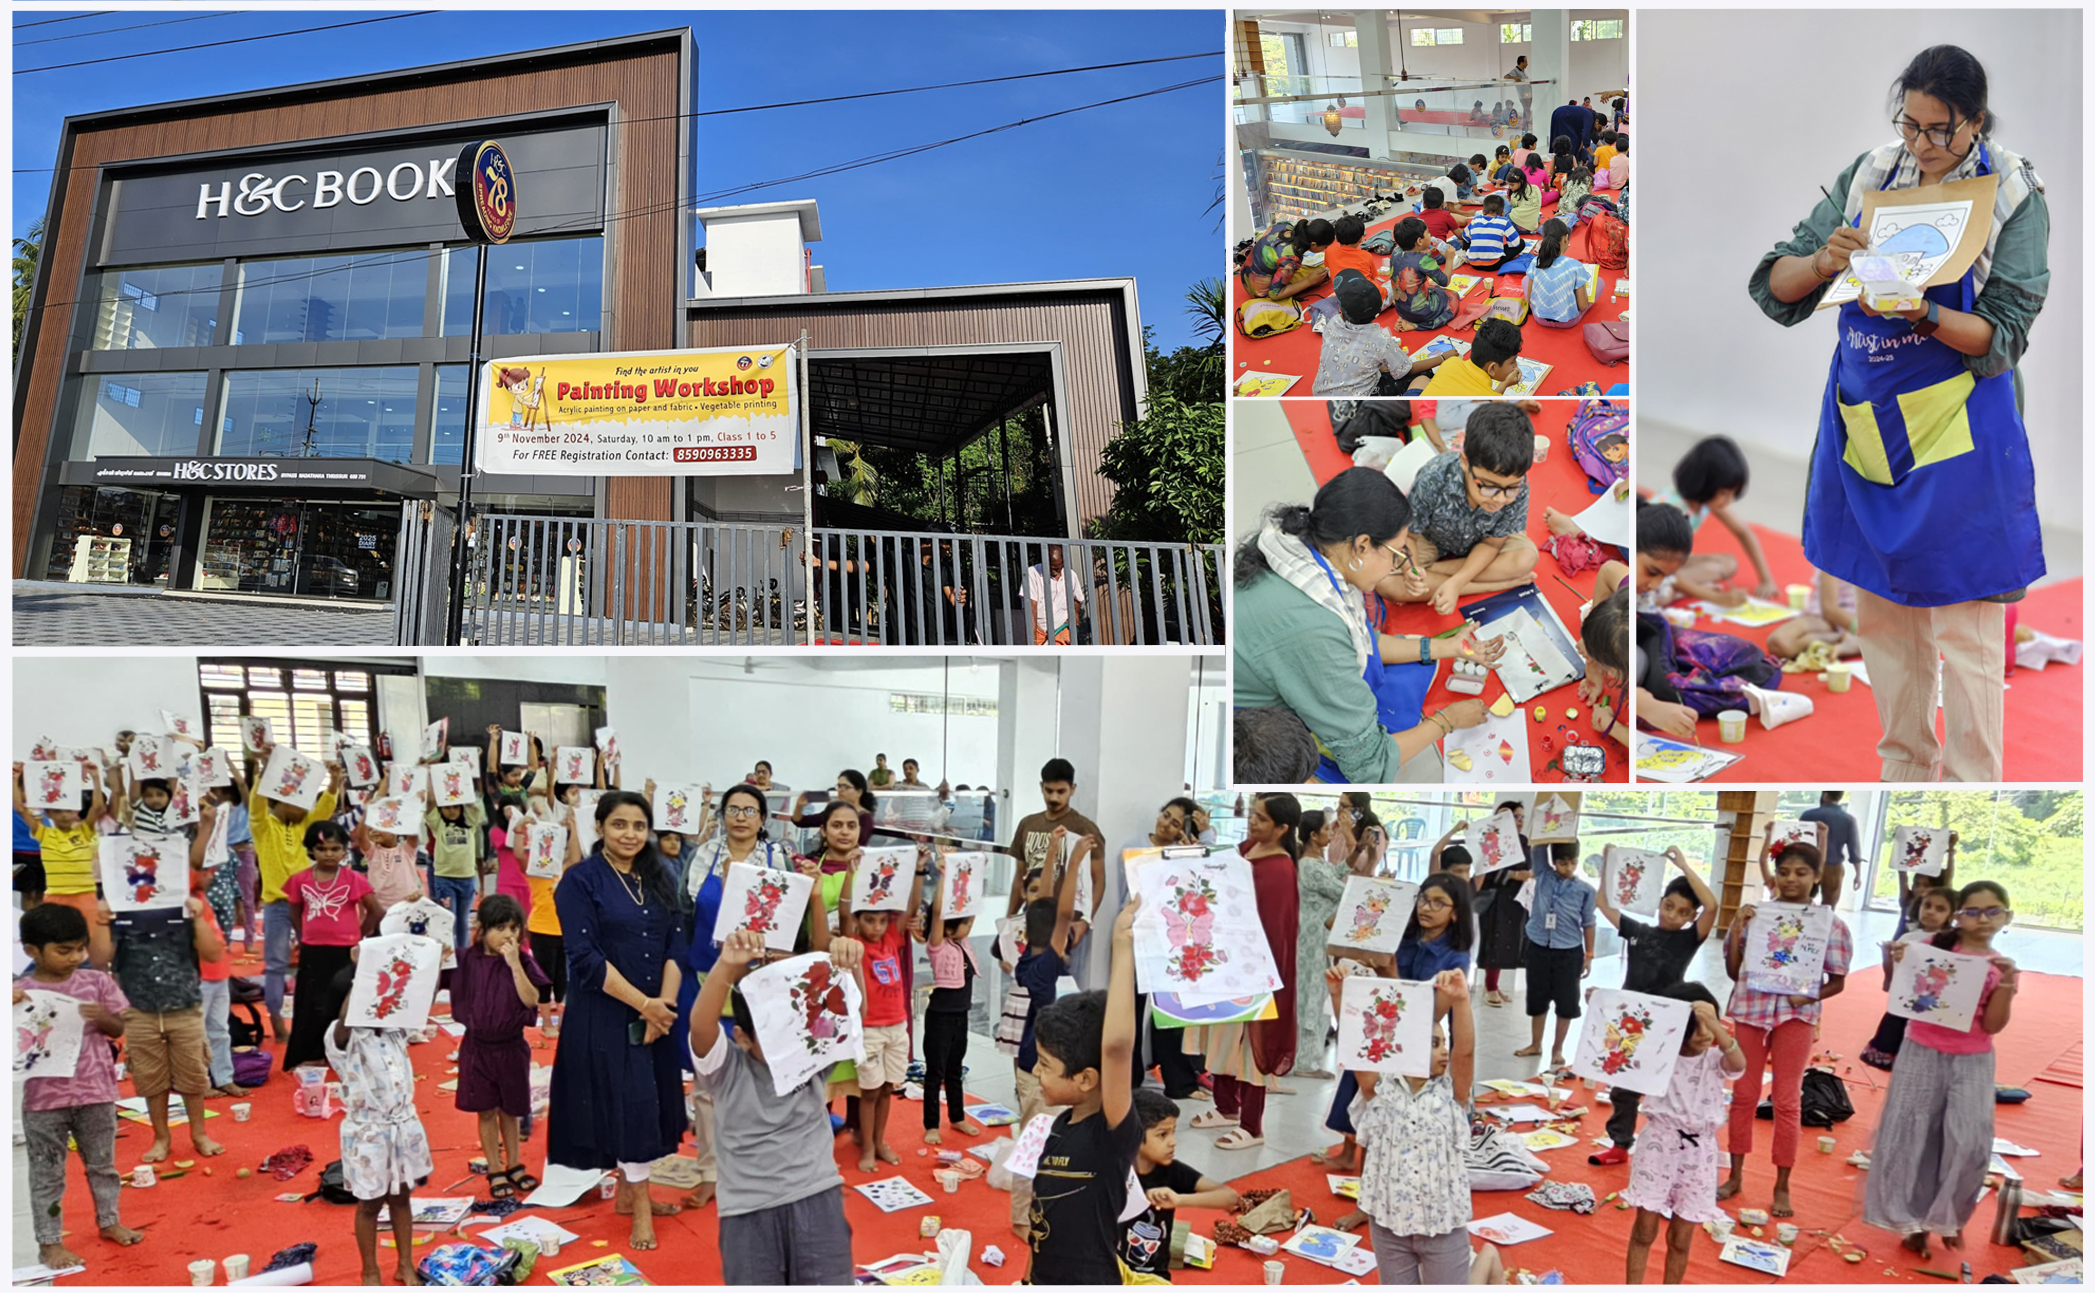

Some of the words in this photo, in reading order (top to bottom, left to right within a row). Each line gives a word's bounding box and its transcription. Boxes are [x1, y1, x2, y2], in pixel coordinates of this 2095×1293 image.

[195, 172, 309, 220] H&C
[1881, 336, 1900, 349] in
[615, 366, 633, 377] Find
[634, 366, 647, 376] the
[649, 365, 672, 374] artist
[673, 365, 682, 375] in
[682, 366, 699, 375] you
[557, 380, 648, 403] Painting
[653, 375, 775, 399] Workshop
[558, 405, 582, 415] Acrylic
[584, 404, 614, 414] painting
[628, 405, 651, 414] paper
[652, 403, 667, 411] and
[670, 402, 693, 411] fabric
[700, 400, 741, 412] Vegetable
[744, 400, 777, 410] printing
[497, 433, 510, 444] 9th
[512, 433, 561, 444] November
[563, 433, 594, 445] 2024,
[597, 434, 639, 445] Saturday,
[642, 434, 654, 443] 10
[673, 434, 684, 443] to
[687, 434, 692, 442] 1
[717, 431, 743, 442] Class
[747, 431, 752, 441] 1
[756, 431, 767, 440] to
[770, 430, 776, 440] 5
[512, 450, 530, 460] For
[532, 450, 557, 460] FREE
[560, 450, 622, 463] Registration
[625, 450, 669, 461] Contact:
[676, 447, 753, 461] 8590963335
[172, 460, 213, 480] H&C
[213, 463, 278, 481] STORES
[1025, 831, 1066, 866] HOUSN
